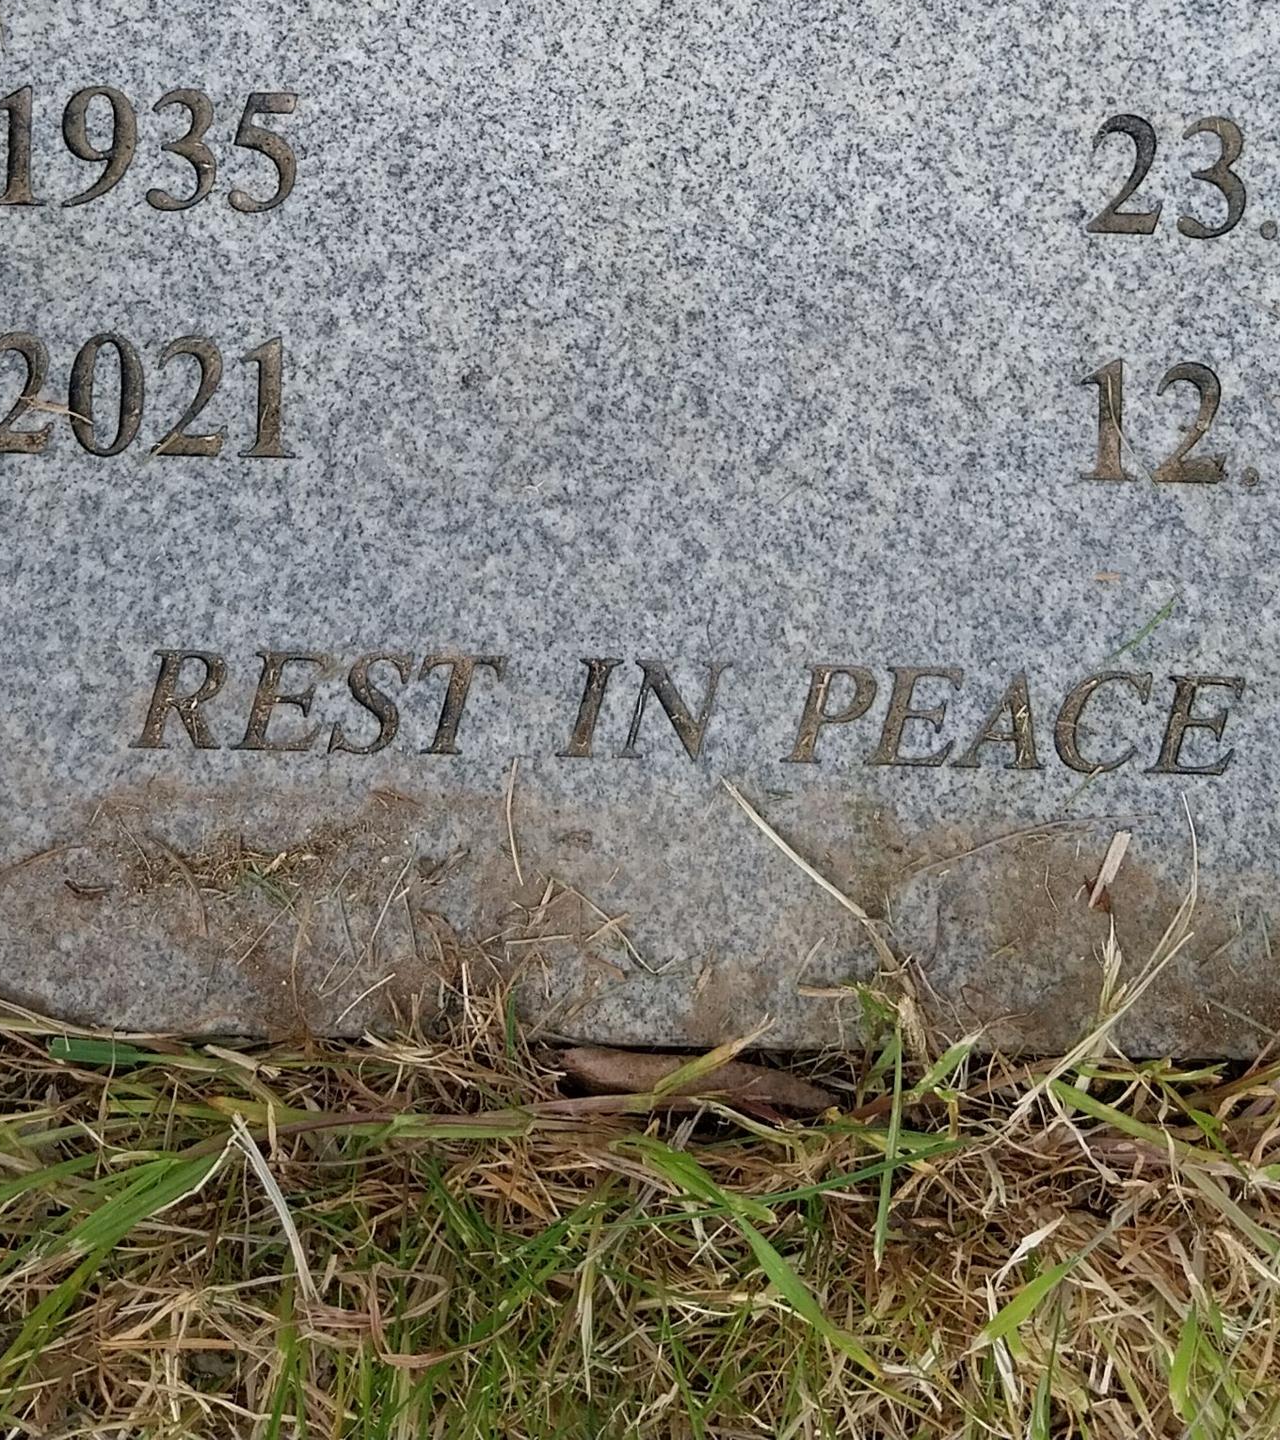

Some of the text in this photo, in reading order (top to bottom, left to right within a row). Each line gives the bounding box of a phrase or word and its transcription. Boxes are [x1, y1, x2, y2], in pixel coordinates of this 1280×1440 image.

[1085, 112, 1280, 241] 23.
[1081, 360, 1261, 487] 12.
[131, 649, 1248, 777] REST IN PEACE
